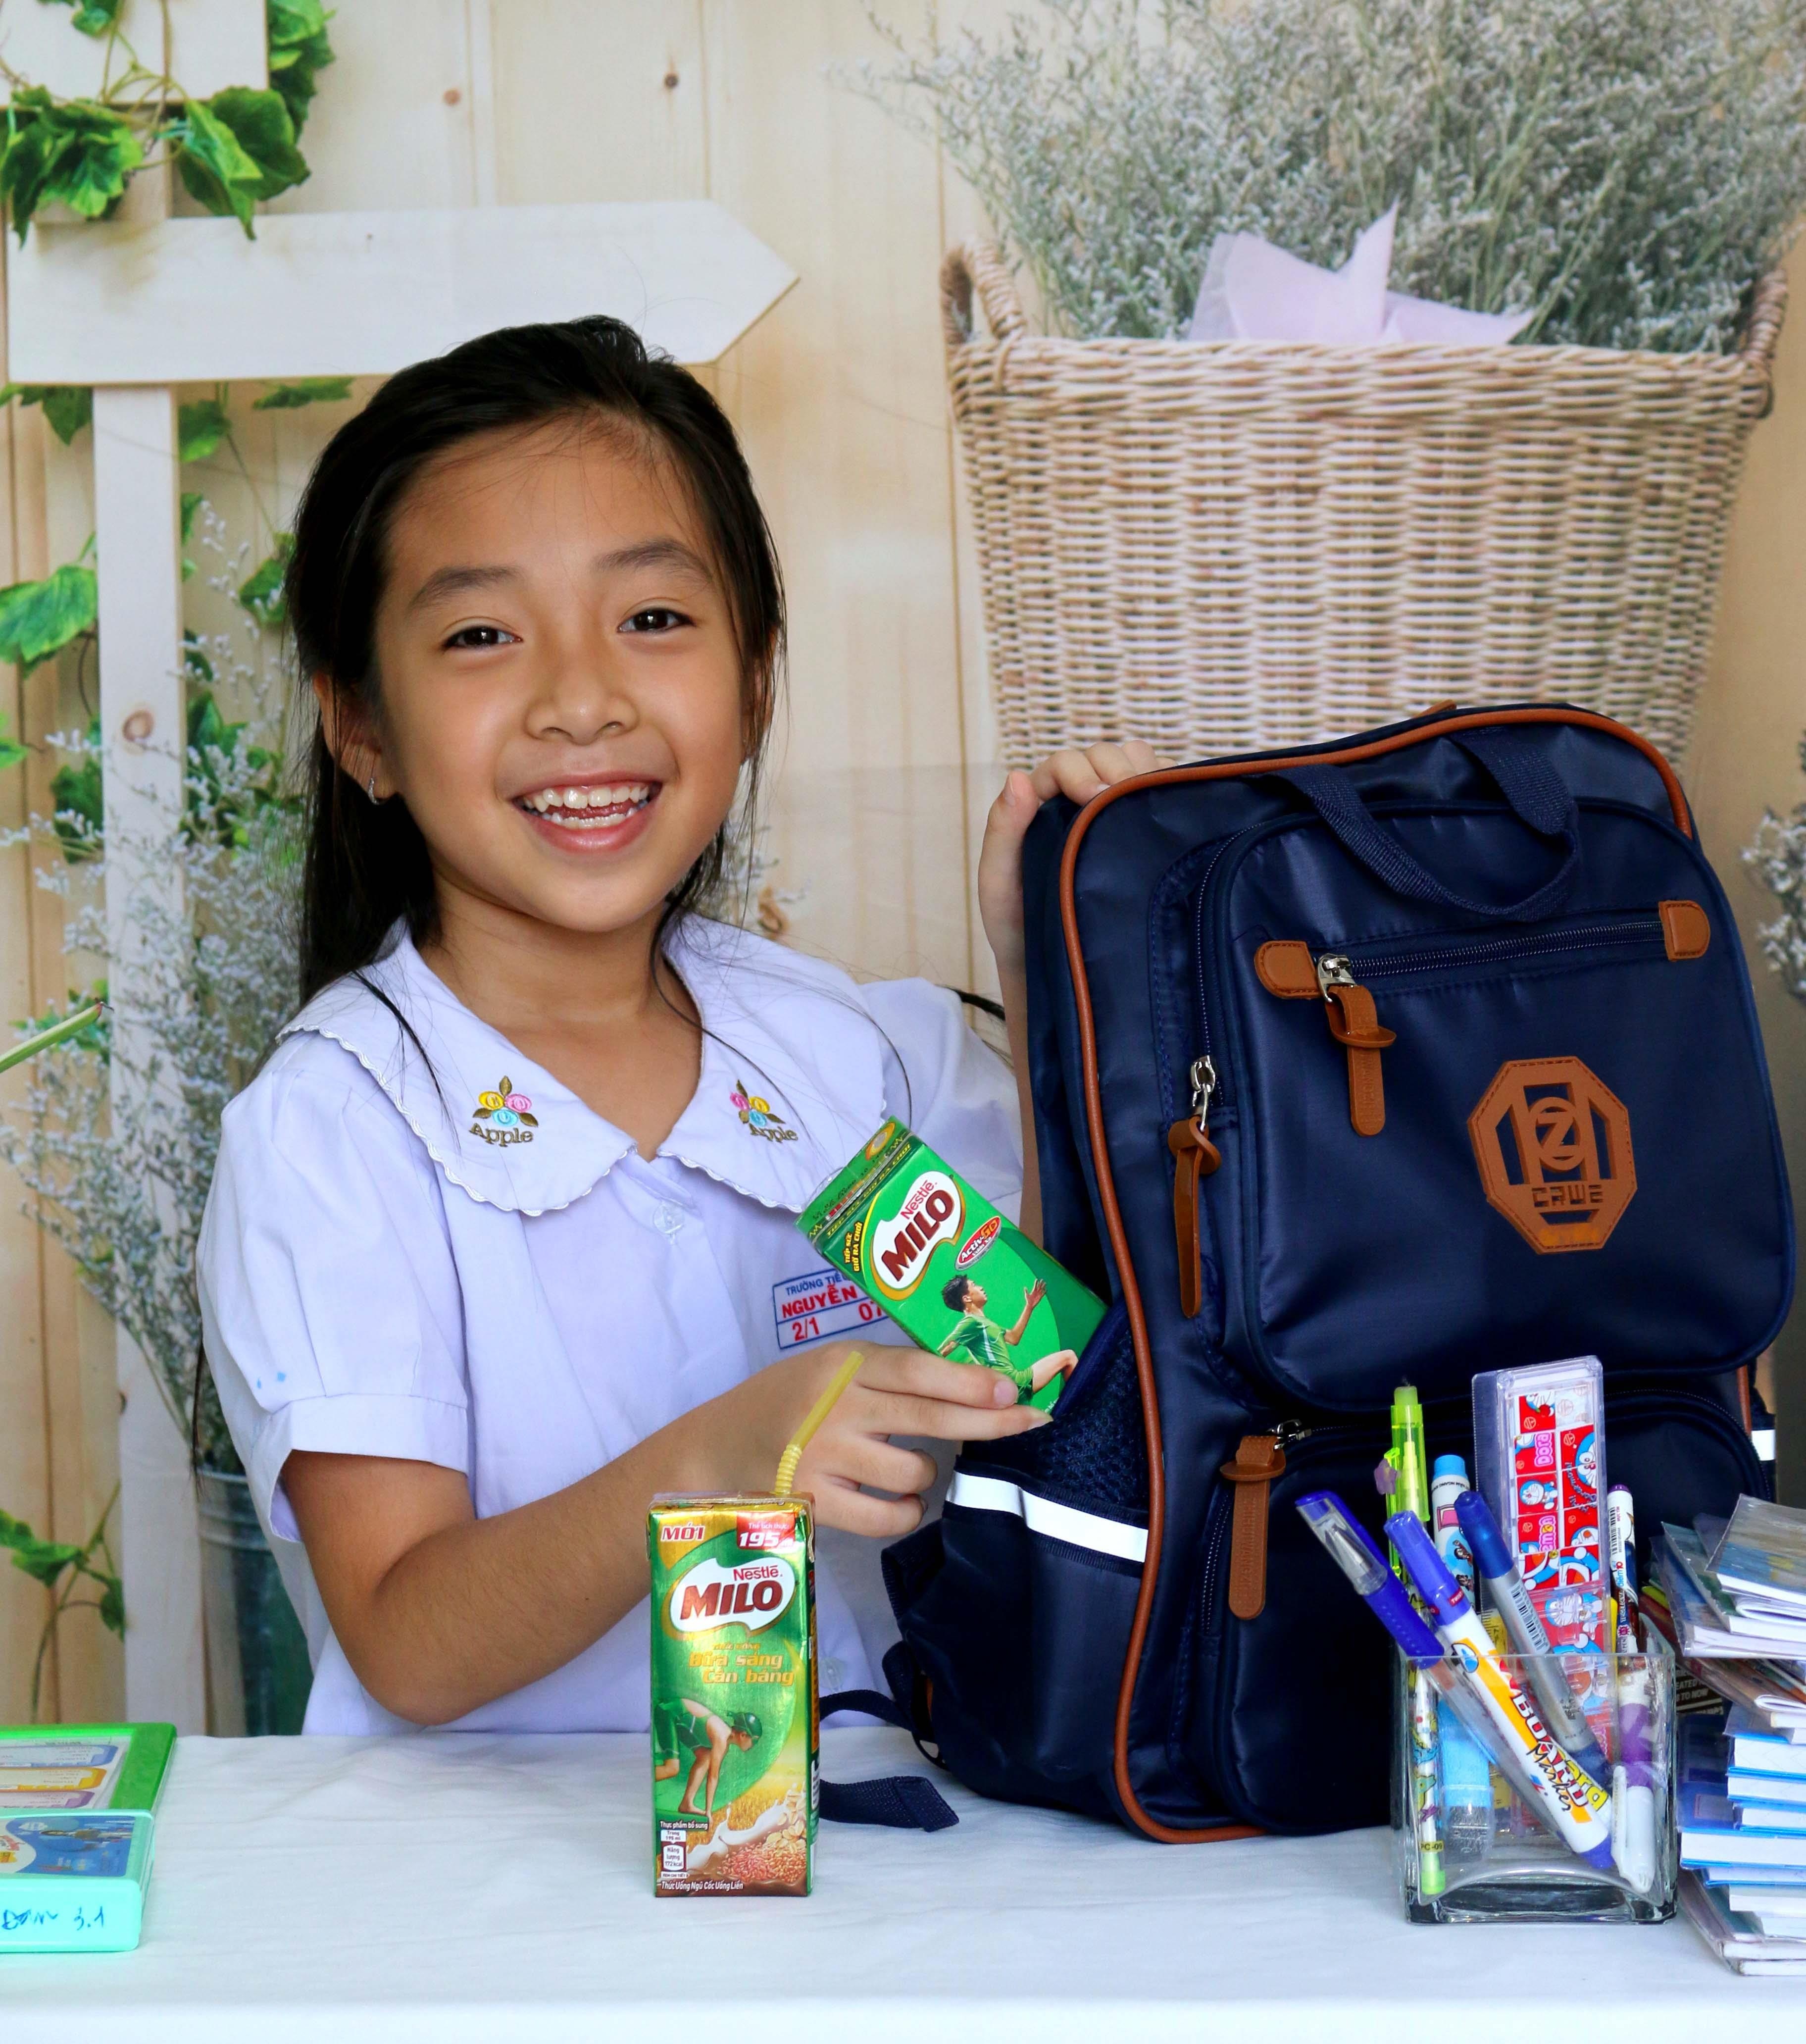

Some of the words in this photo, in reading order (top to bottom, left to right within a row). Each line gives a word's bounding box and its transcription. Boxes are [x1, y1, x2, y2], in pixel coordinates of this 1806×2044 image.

[469, 1123, 533, 1147] Apple
[749, 1123, 799, 1143] Apple
[881, 1189, 954, 1281] MILO
[853, 1243, 859, 1256] RA
[786, 1277, 824, 1296] TRƯỜNG
[782, 1284, 857, 1319] NGUYỄN
[792, 1317, 820, 1341] 2/1
[661, 1521, 705, 1542] MỚI
[740, 1532, 781, 1547] 195
[680, 1580, 783, 1621] MILO
[736, 1650, 784, 1670] sáng
[1513, 1694, 1589, 1806] BOARD
[1526, 1742, 1572, 1812] Marker
